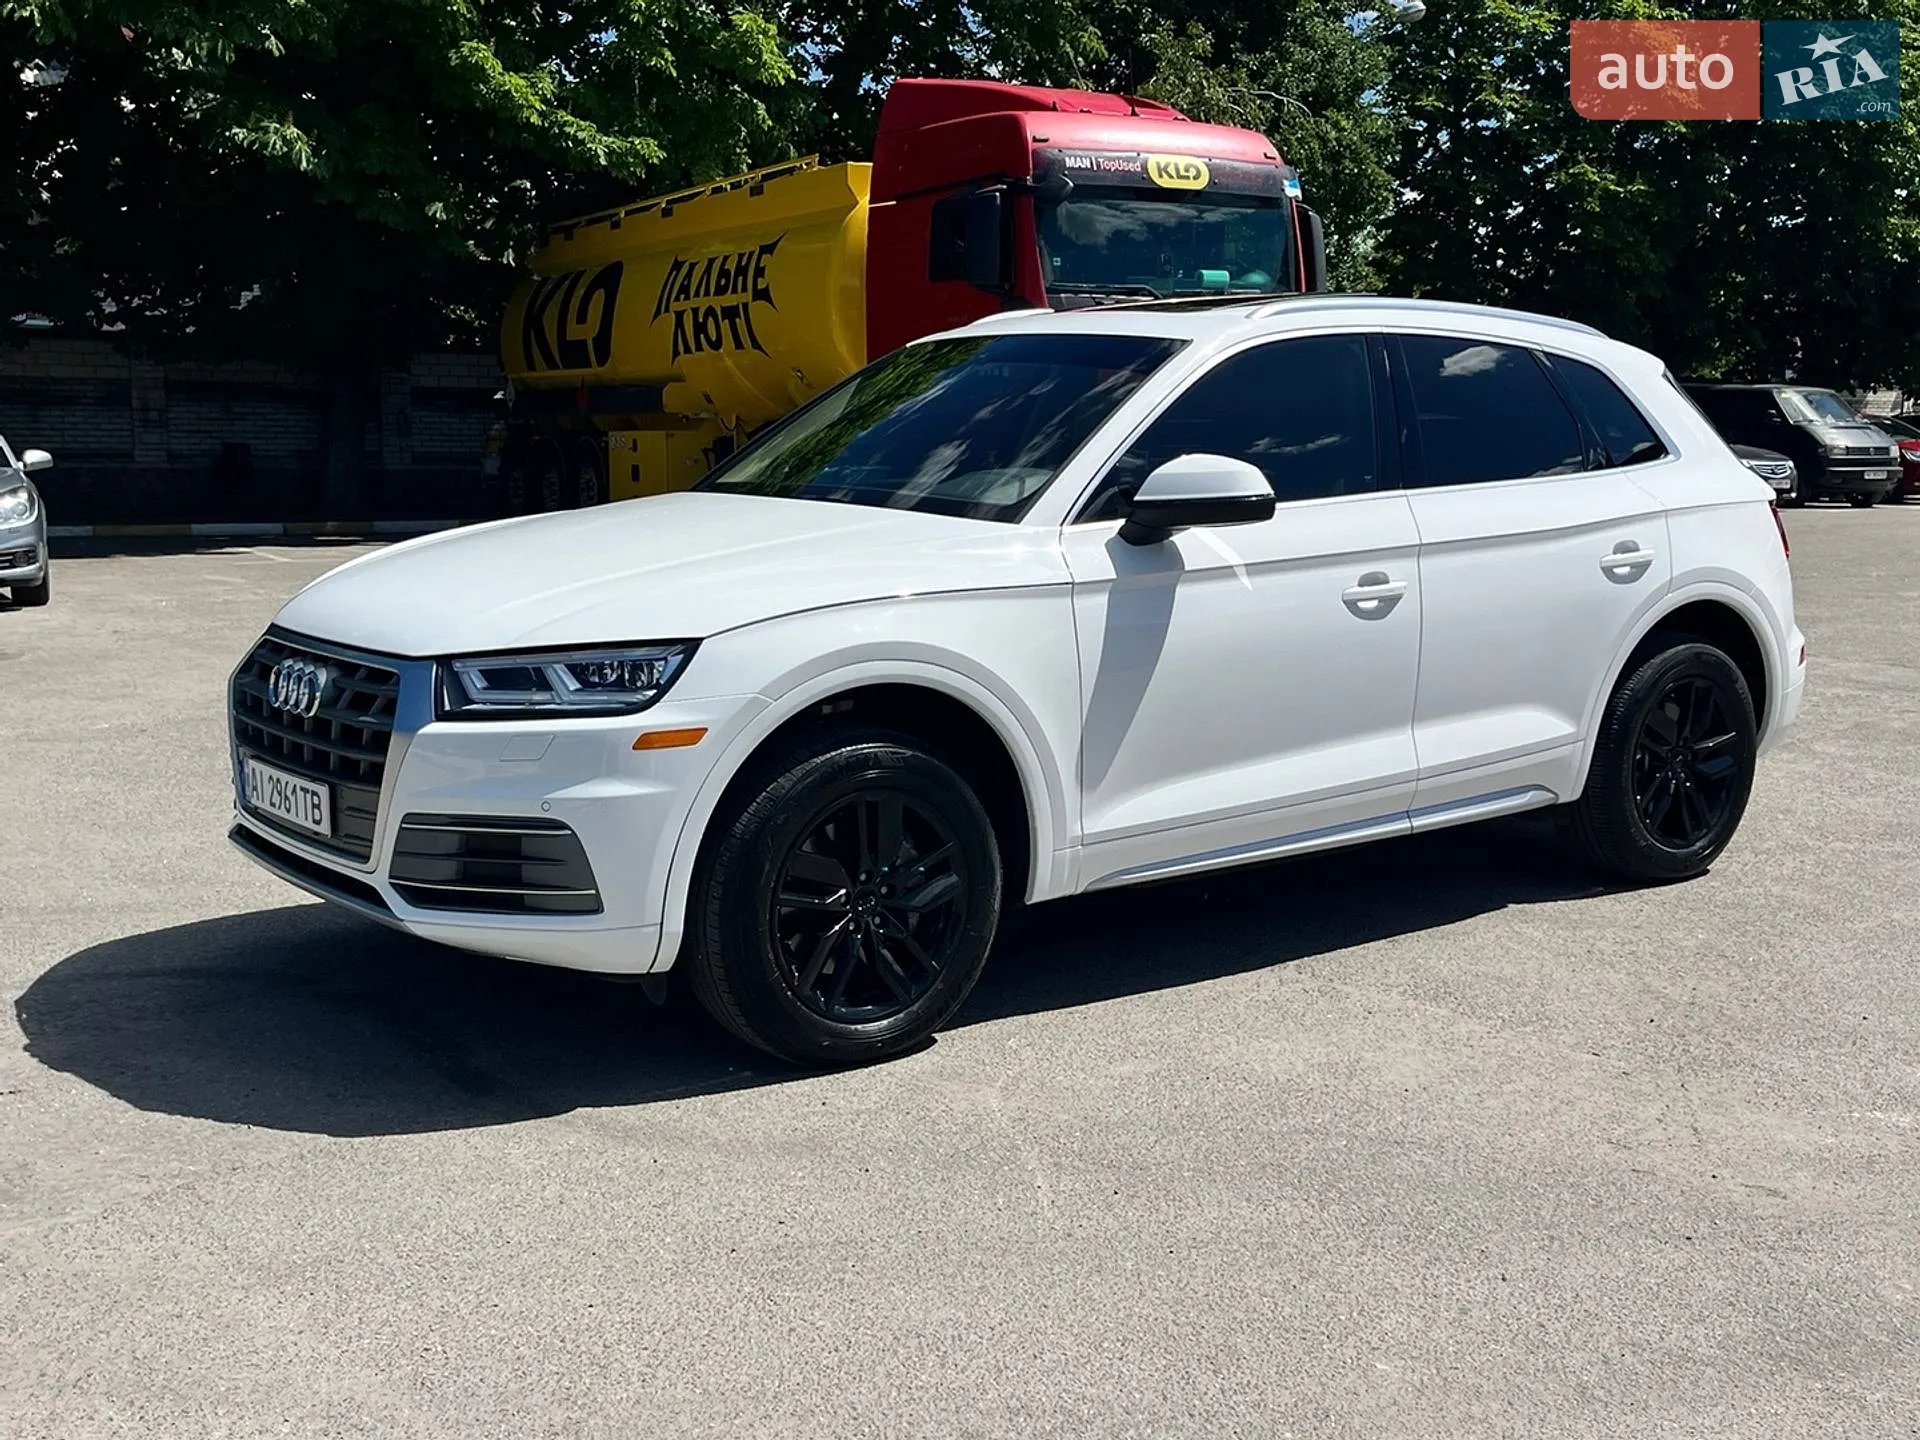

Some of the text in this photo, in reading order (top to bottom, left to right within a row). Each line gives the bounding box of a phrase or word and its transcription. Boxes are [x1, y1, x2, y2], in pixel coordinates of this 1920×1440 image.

[1065, 156, 1142, 172] MAN TopUsed
[1156, 161, 1202, 181] KLO
[650, 230, 790, 328] ПАЛЬНЕ
[522, 260, 624, 371] KLO
[671, 302, 773, 366] ЛЮТІ
